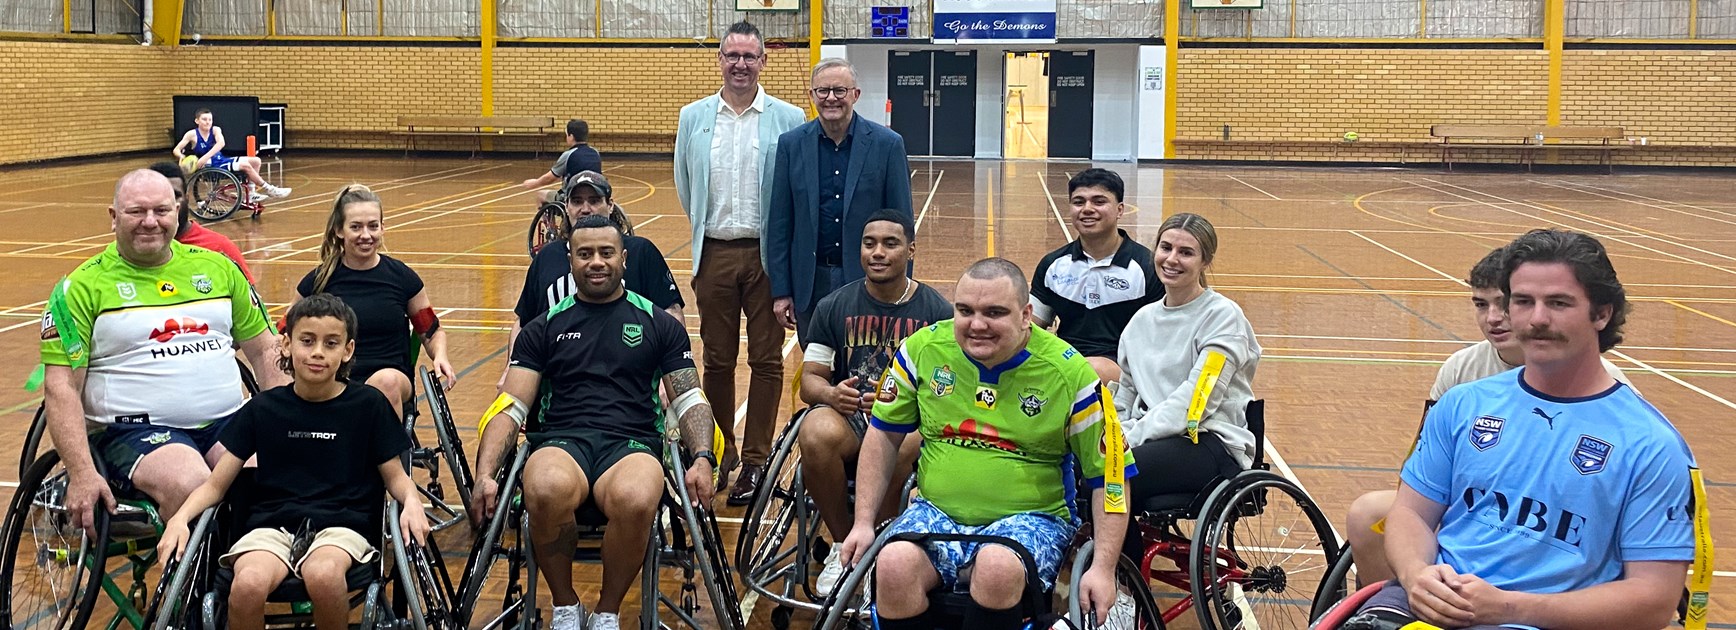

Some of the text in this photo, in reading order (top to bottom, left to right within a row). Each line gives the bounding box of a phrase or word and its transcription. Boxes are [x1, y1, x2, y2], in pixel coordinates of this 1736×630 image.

[943, 19, 1047, 35] Go the Demons
[844, 316, 929, 348] NIRVAN
[151, 339, 222, 359] HUAWEI
[937, 371, 953, 381] NRL
[1475, 418, 1502, 429] NSW
[1582, 438, 1608, 452] NSW
